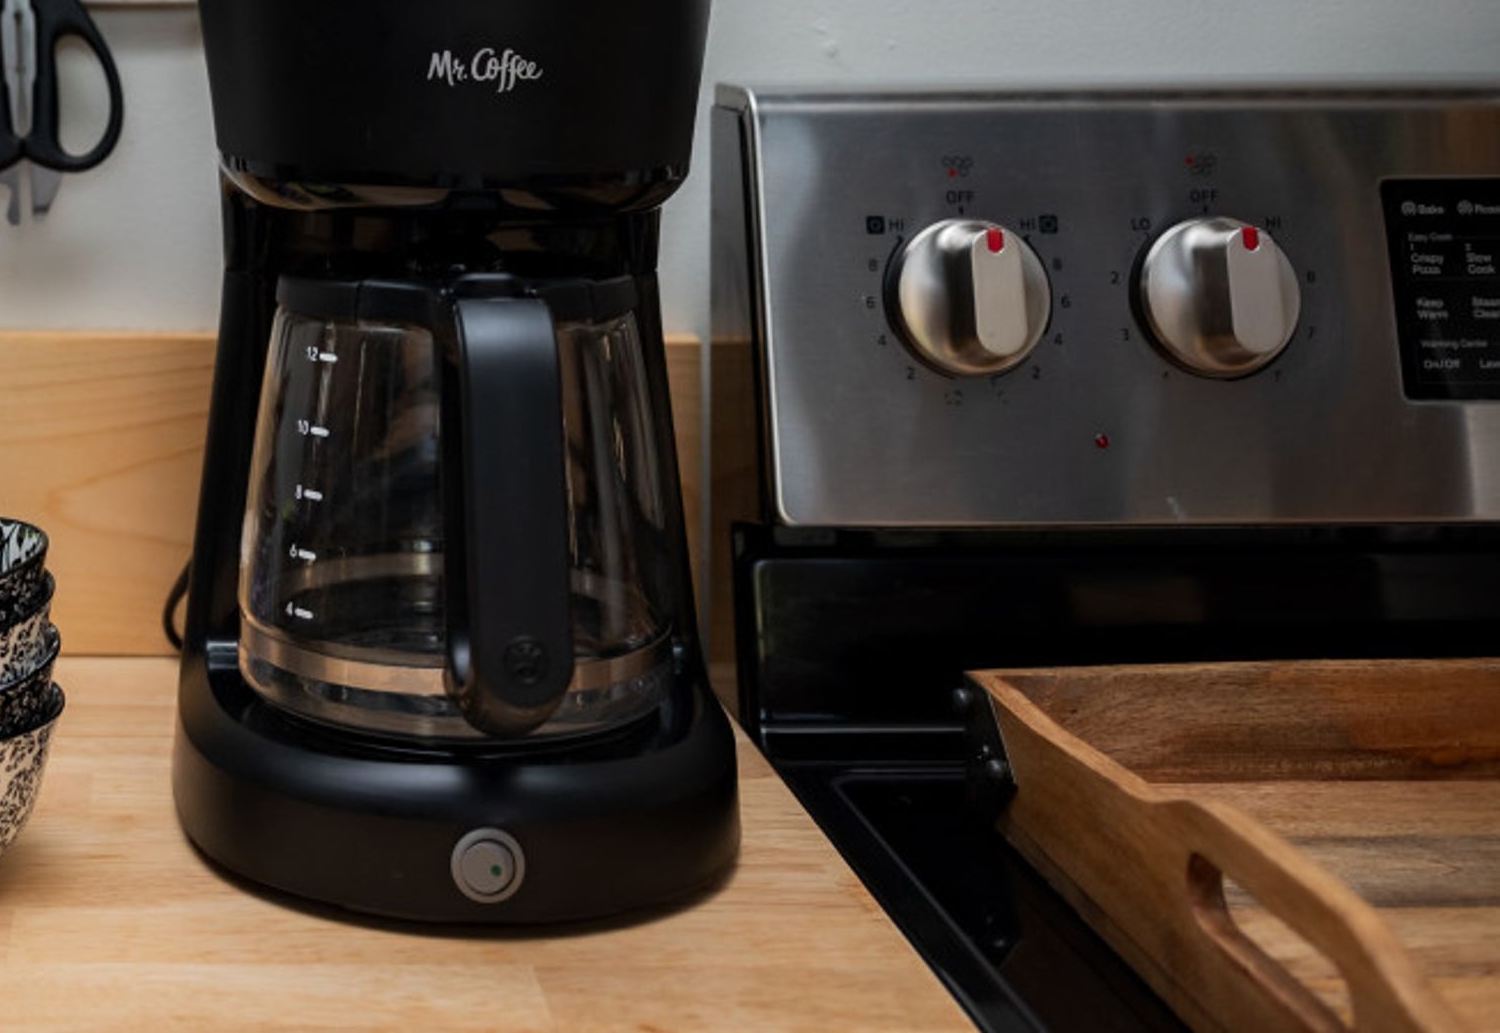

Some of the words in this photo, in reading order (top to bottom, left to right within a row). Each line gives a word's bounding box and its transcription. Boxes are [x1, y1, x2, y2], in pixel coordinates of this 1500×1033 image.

[427, 50, 468, 86] Mr.
[471, 47, 543, 93] Coffee
[946, 191, 975, 204] OFF
[1189, 190, 1218, 202] OFF
[888, 219, 904, 230] HI
[1020, 218, 1035, 230] HI
[1131, 218, 1149, 230] LO
[1265, 217, 1280, 228] HI
[306, 346, 318, 361] 12
[298, 419, 309, 435] 10
[295, 484, 302, 499] 8
[289, 543, 297, 558] 6
[285, 600, 293, 616] 4
